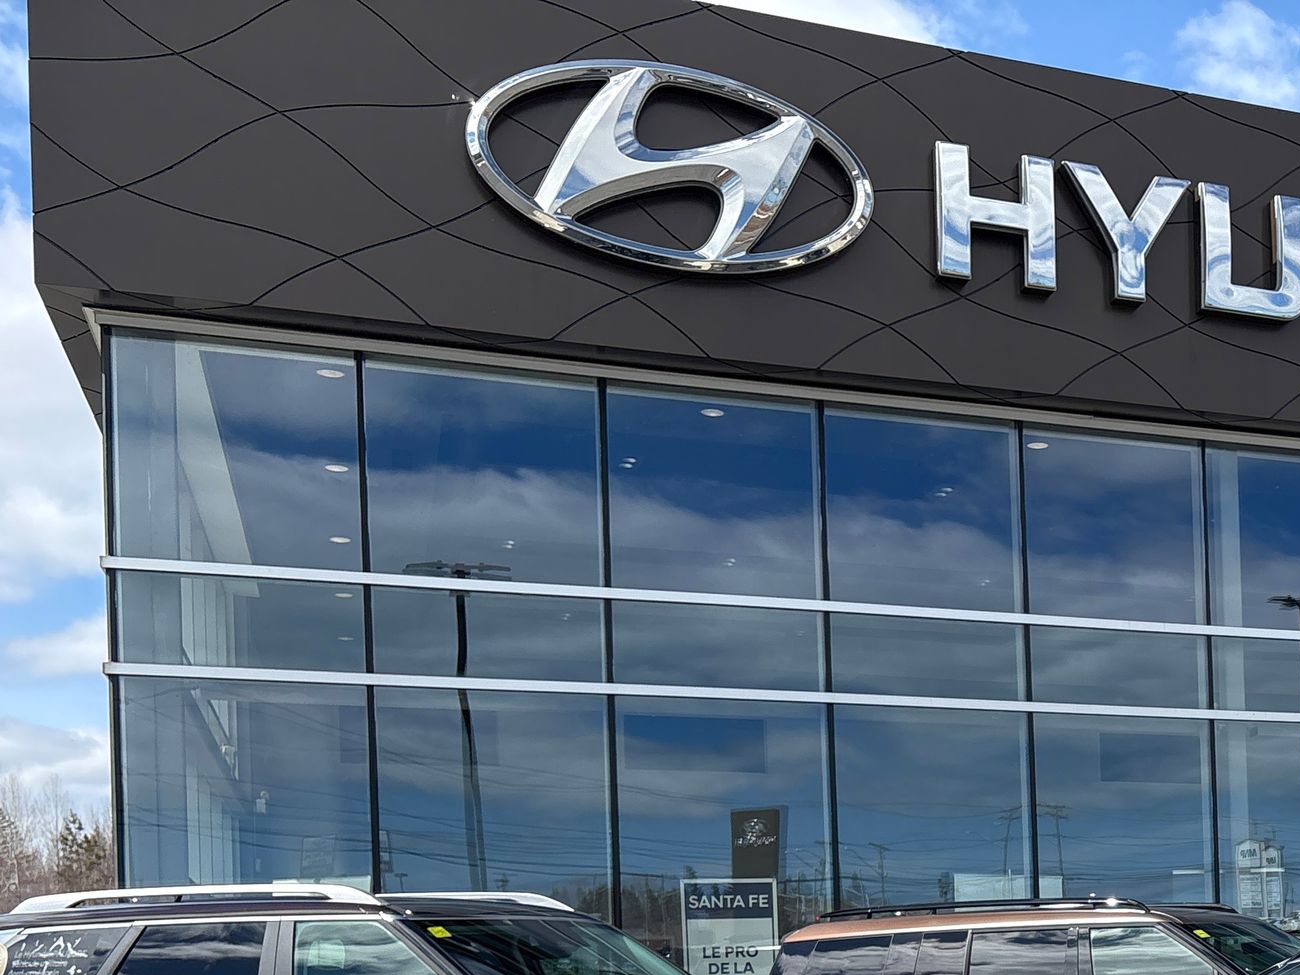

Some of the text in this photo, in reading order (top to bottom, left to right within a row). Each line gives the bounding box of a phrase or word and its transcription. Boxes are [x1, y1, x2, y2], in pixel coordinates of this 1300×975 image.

[688, 894, 769, 909] SANTA FE
[702, 945, 759, 959] LE PRO
[708, 961, 755, 975] DE LA
